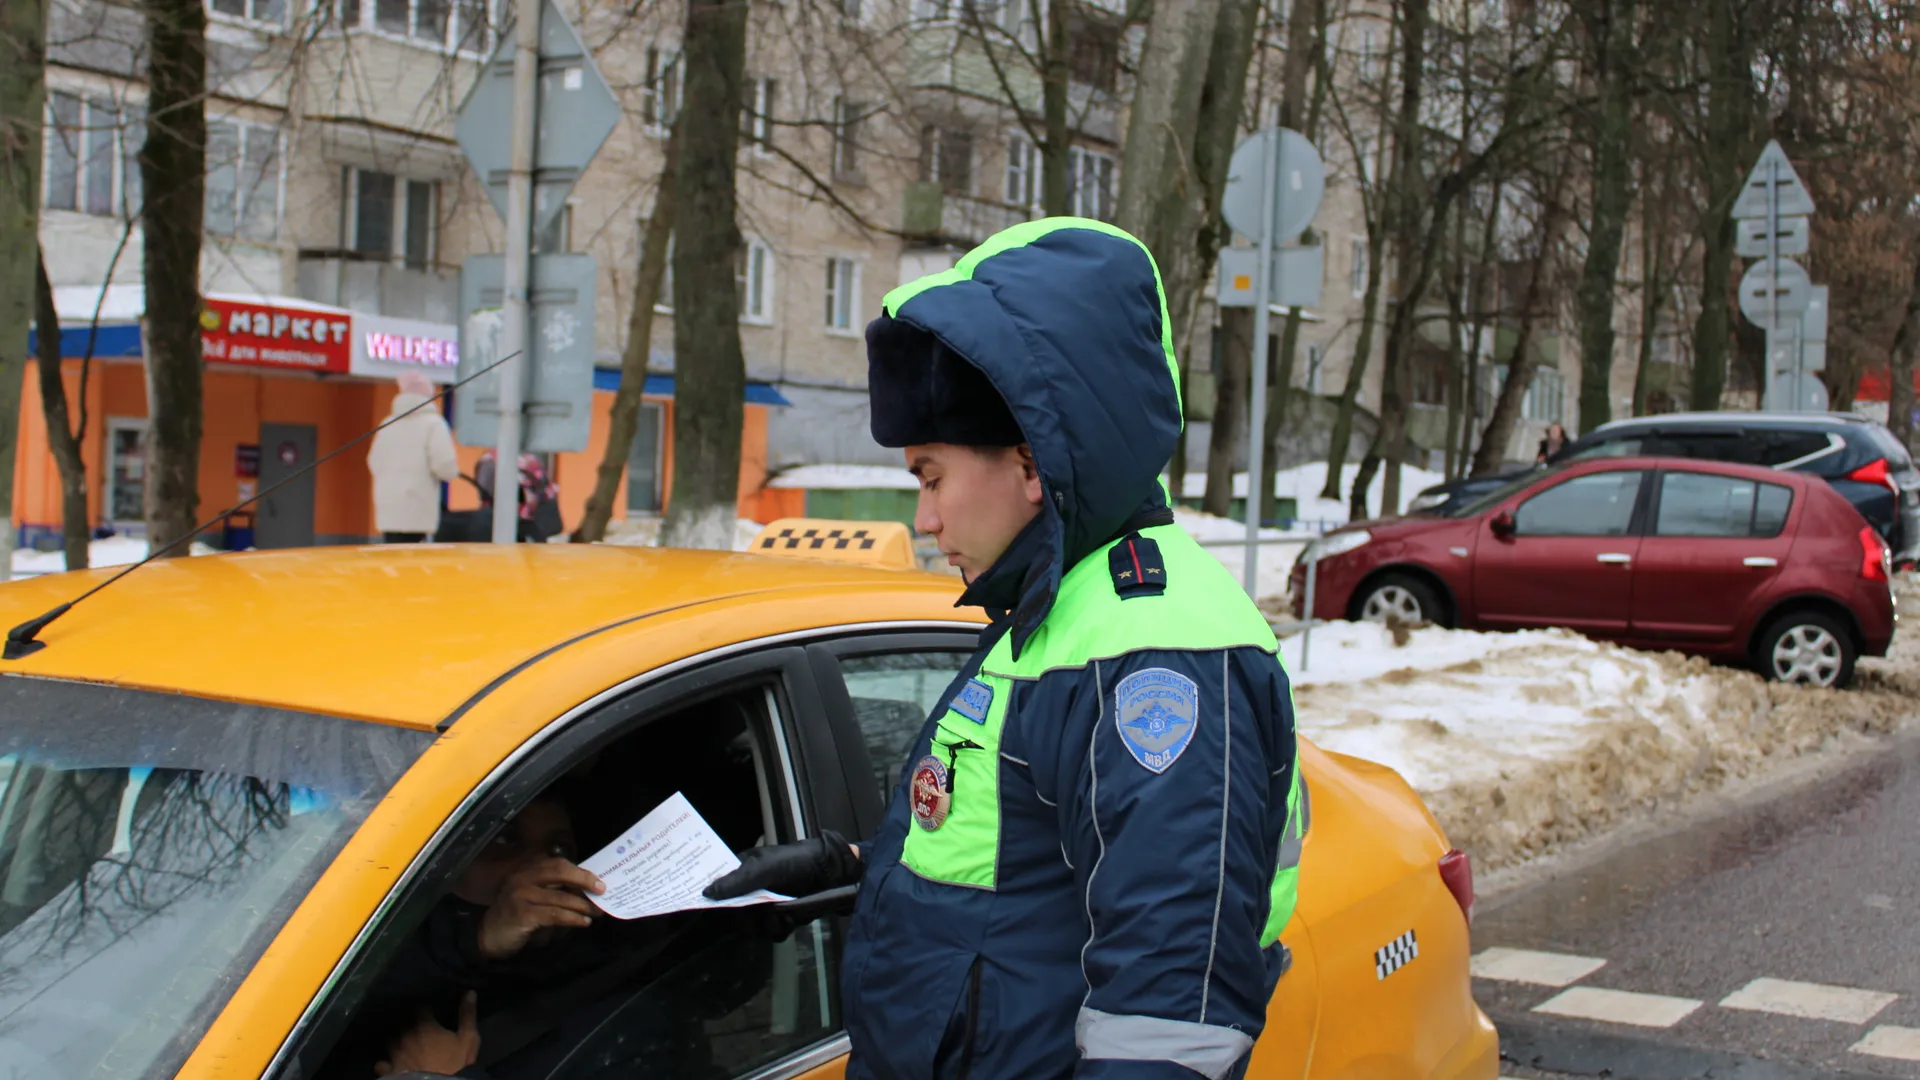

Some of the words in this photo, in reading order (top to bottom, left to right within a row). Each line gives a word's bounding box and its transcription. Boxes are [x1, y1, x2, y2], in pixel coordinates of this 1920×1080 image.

[1122, 674, 1191, 697] ПОЛИЦИЯ
[1130, 690, 1184, 707] РОССИЯ
[1144, 749, 1171, 767] МВД
[917, 802, 931, 816] ДПС
[651, 811, 691, 843] РОДИТЕЛЕЙ!
